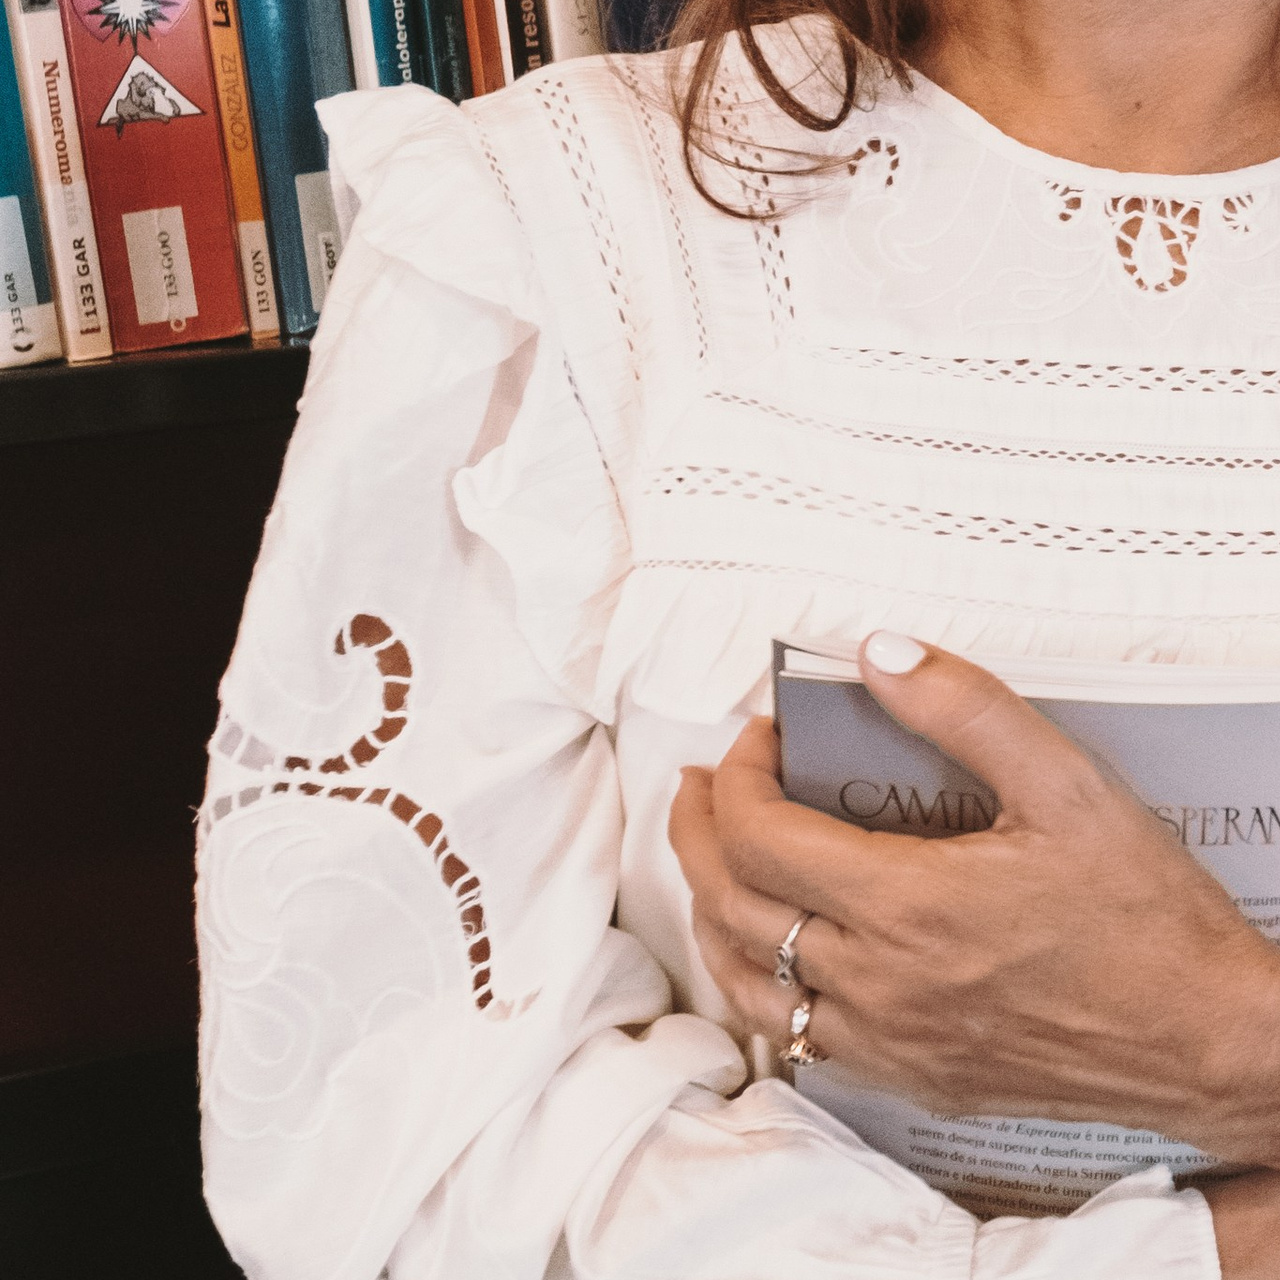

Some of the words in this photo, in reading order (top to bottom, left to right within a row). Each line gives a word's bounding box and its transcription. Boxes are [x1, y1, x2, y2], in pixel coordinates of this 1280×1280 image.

[72, 235, 91, 278] GAR
[251, 249, 267, 286] GON
[4, 272, 19, 305] GAR
[79, 280, 99, 319] 133
[257, 288, 271, 314] 133
[908, 1125, 946, 1142] quem
[949, 1131, 987, 1150] deseja
[988, 1139, 1038, 1156] superar
[1040, 1145, 1093, 1161] desafios
[1095, 1151, 1174, 1165] emocionais
[996, 1120, 1012, 1133] de
[1014, 1122, 1082, 1142] Esperança
[1096, 1131, 1119, 1144] um
[1123, 1131, 1154, 1147] guia
[909, 1144, 949, 1161] versão
[950, 1150, 965, 1164] de
[966, 1153, 978, 1166] si
[1030, 1162, 1079, 1180] Angela
[961, 1170, 1042, 1194] idealizadora
[1043, 1183, 1059, 1197] de
[1062, 1186, 1093, 1199] uma
